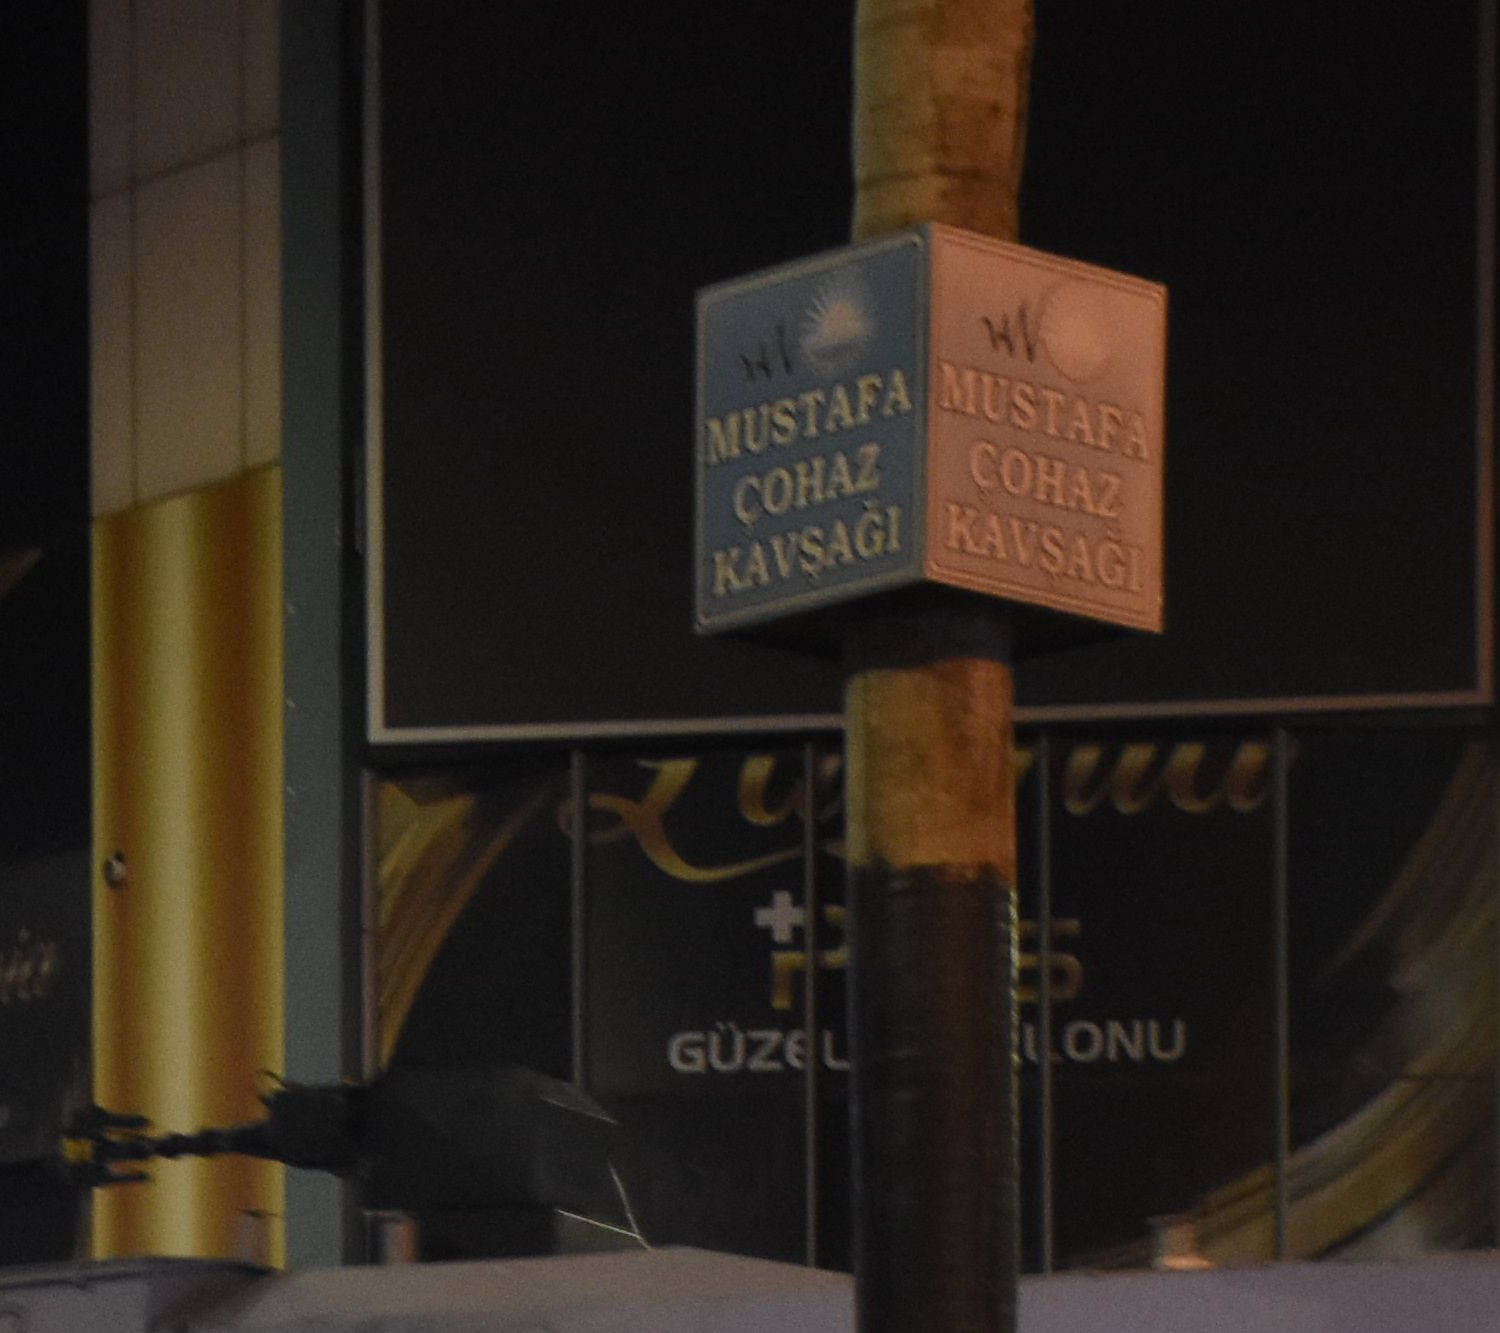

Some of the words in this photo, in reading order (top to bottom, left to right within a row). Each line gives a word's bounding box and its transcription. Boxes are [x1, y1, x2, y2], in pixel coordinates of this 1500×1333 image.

[704, 369, 912, 465] MUSTAFA
[937, 360, 1151, 460] MUSTAFA
[732, 443, 881, 534] ÇOHAZ
[970, 439, 1122, 519] ÇOHAZ
[713, 500, 901, 596] KAVŞAĞI
[666, 1019, 851, 1074] GÜZEL
[1023, 1017, 1188, 1066] LONU
